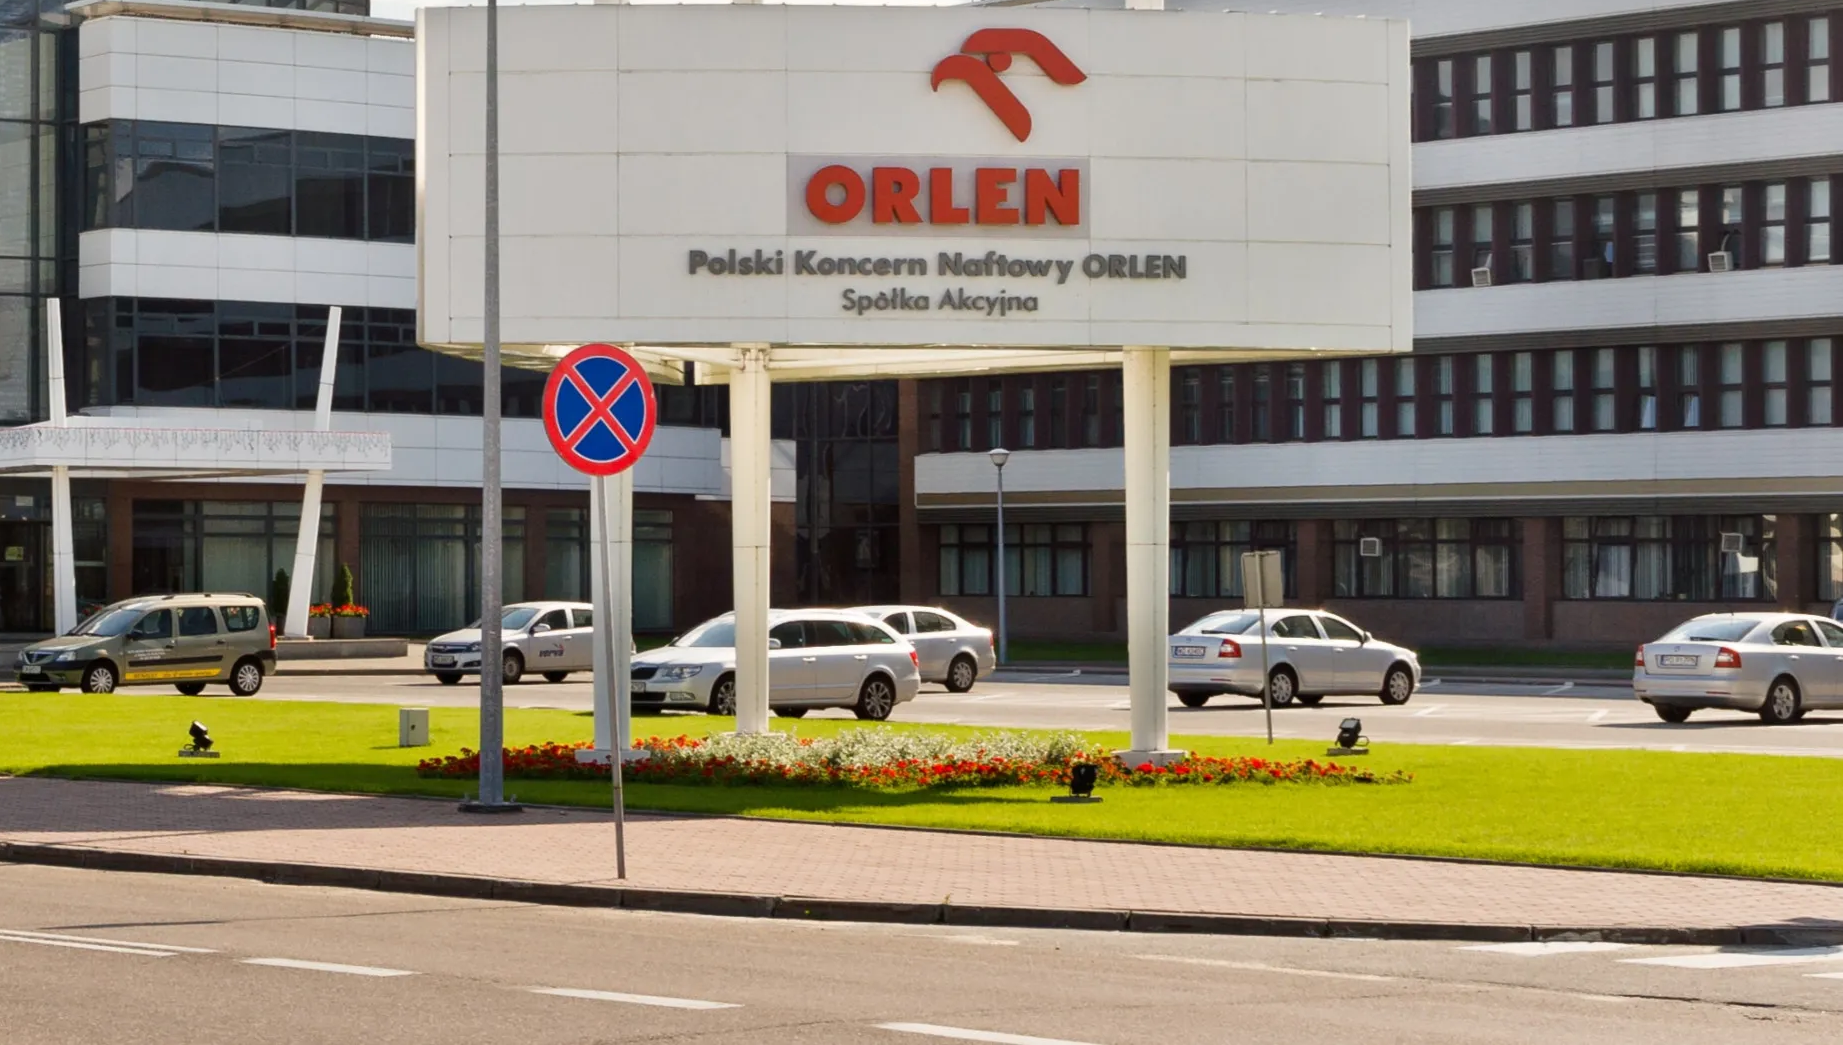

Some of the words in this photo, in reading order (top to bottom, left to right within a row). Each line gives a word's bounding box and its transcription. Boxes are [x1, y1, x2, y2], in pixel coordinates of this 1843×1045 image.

[805, 165, 1080, 225] ORLEN
[689, 249, 784, 275] Polski
[795, 250, 927, 276] Koncern
[938, 251, 1074, 284] Naftowy
[1082, 253, 1187, 279] ORLEN
[938, 288, 1039, 316] Akcyjna
